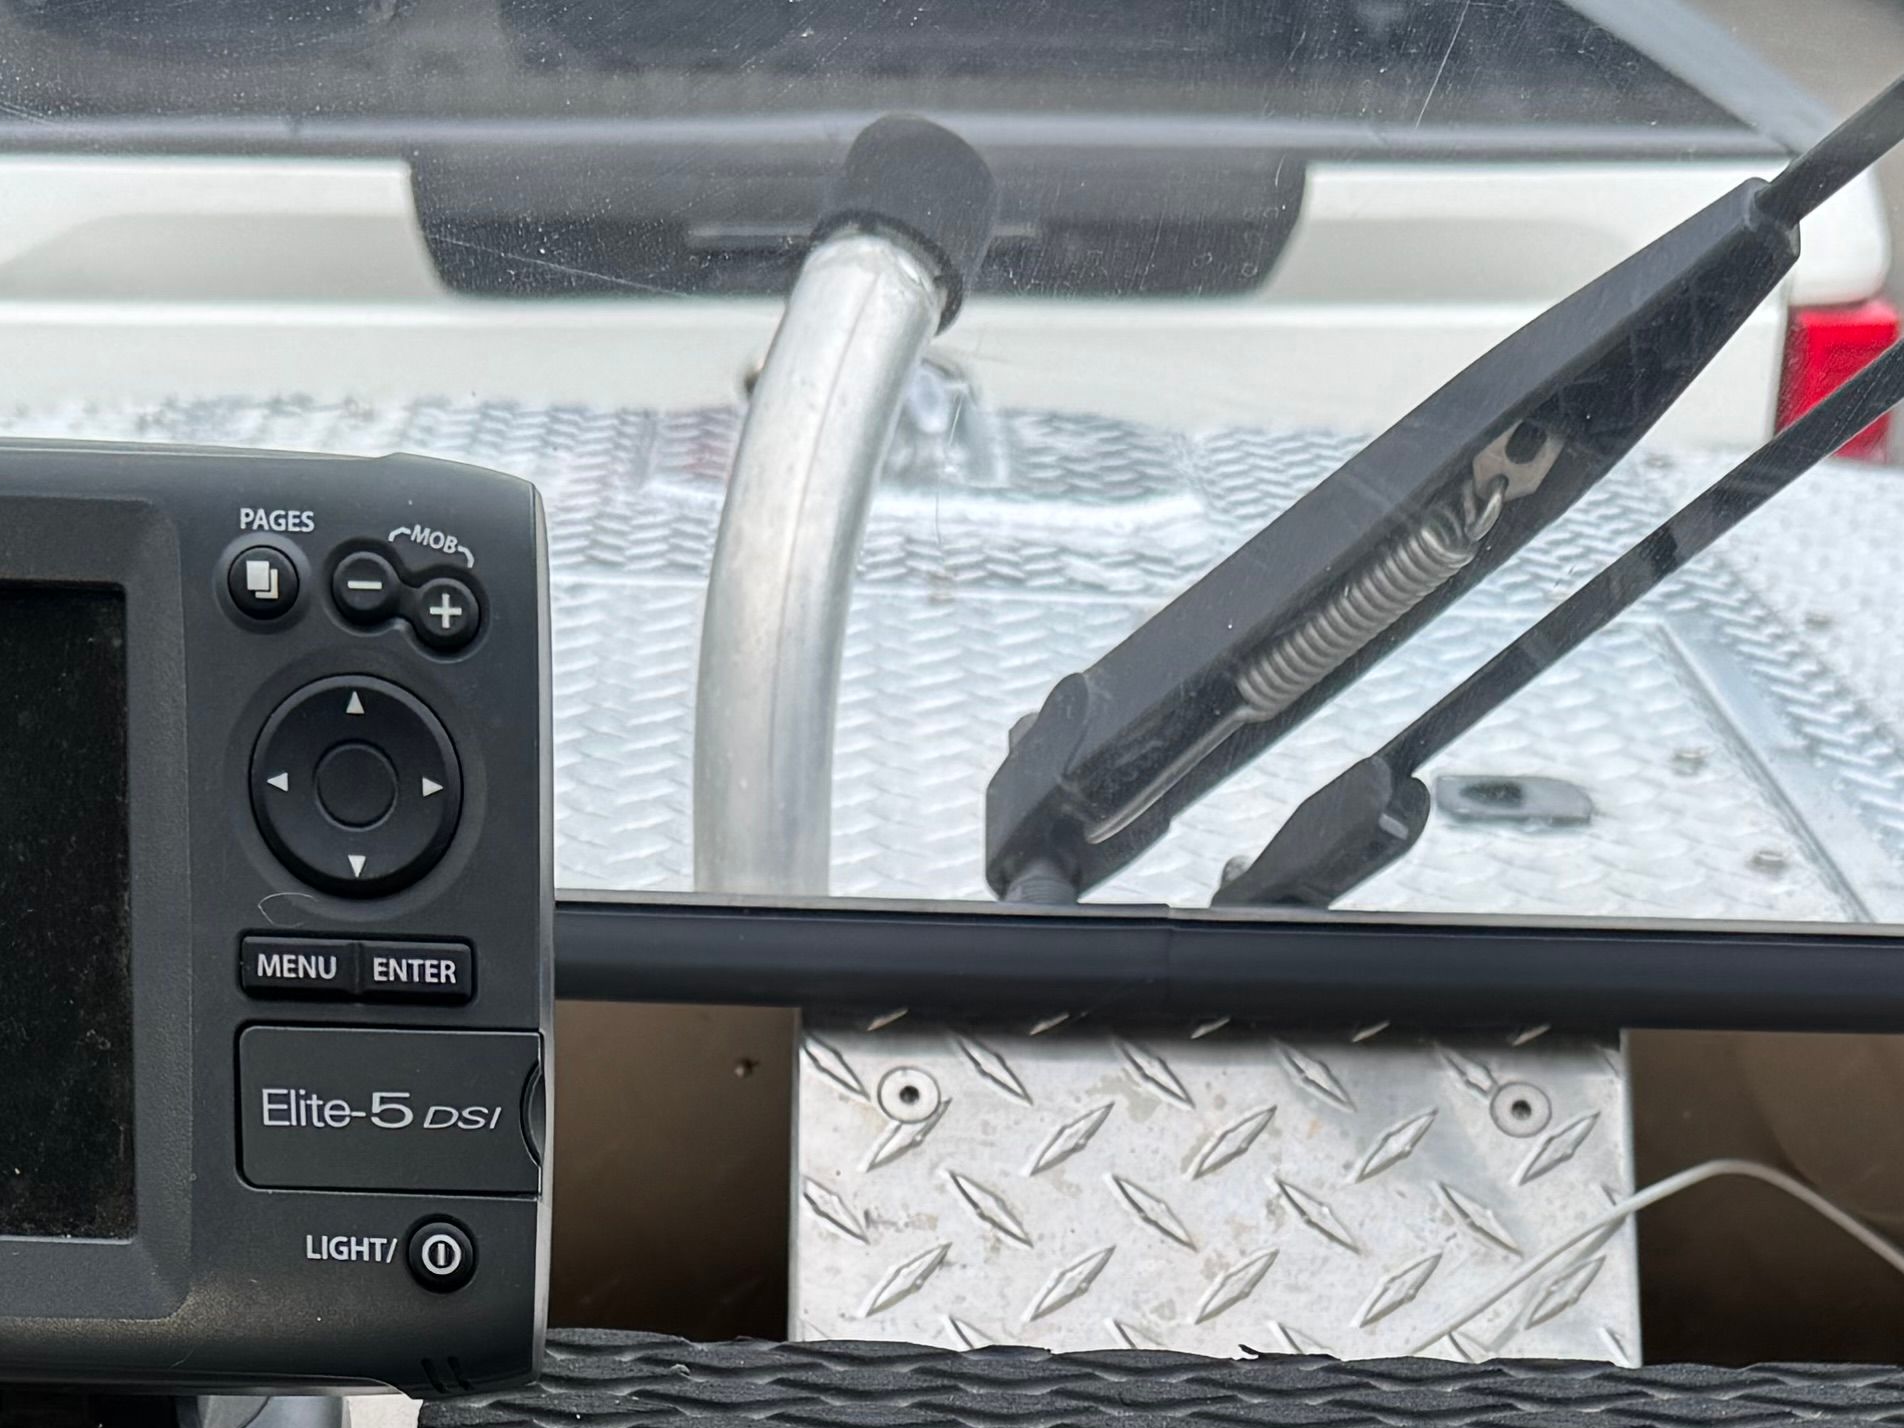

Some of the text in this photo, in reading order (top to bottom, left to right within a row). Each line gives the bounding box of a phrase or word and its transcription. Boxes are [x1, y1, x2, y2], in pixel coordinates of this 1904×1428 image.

[240, 508, 315, 532] PAGES
[410, 524, 458, 554] MOB
[257, 954, 337, 980] MENU
[373, 957, 456, 984] ENTER
[262, 1088, 502, 1130] Elite-5 DSI
